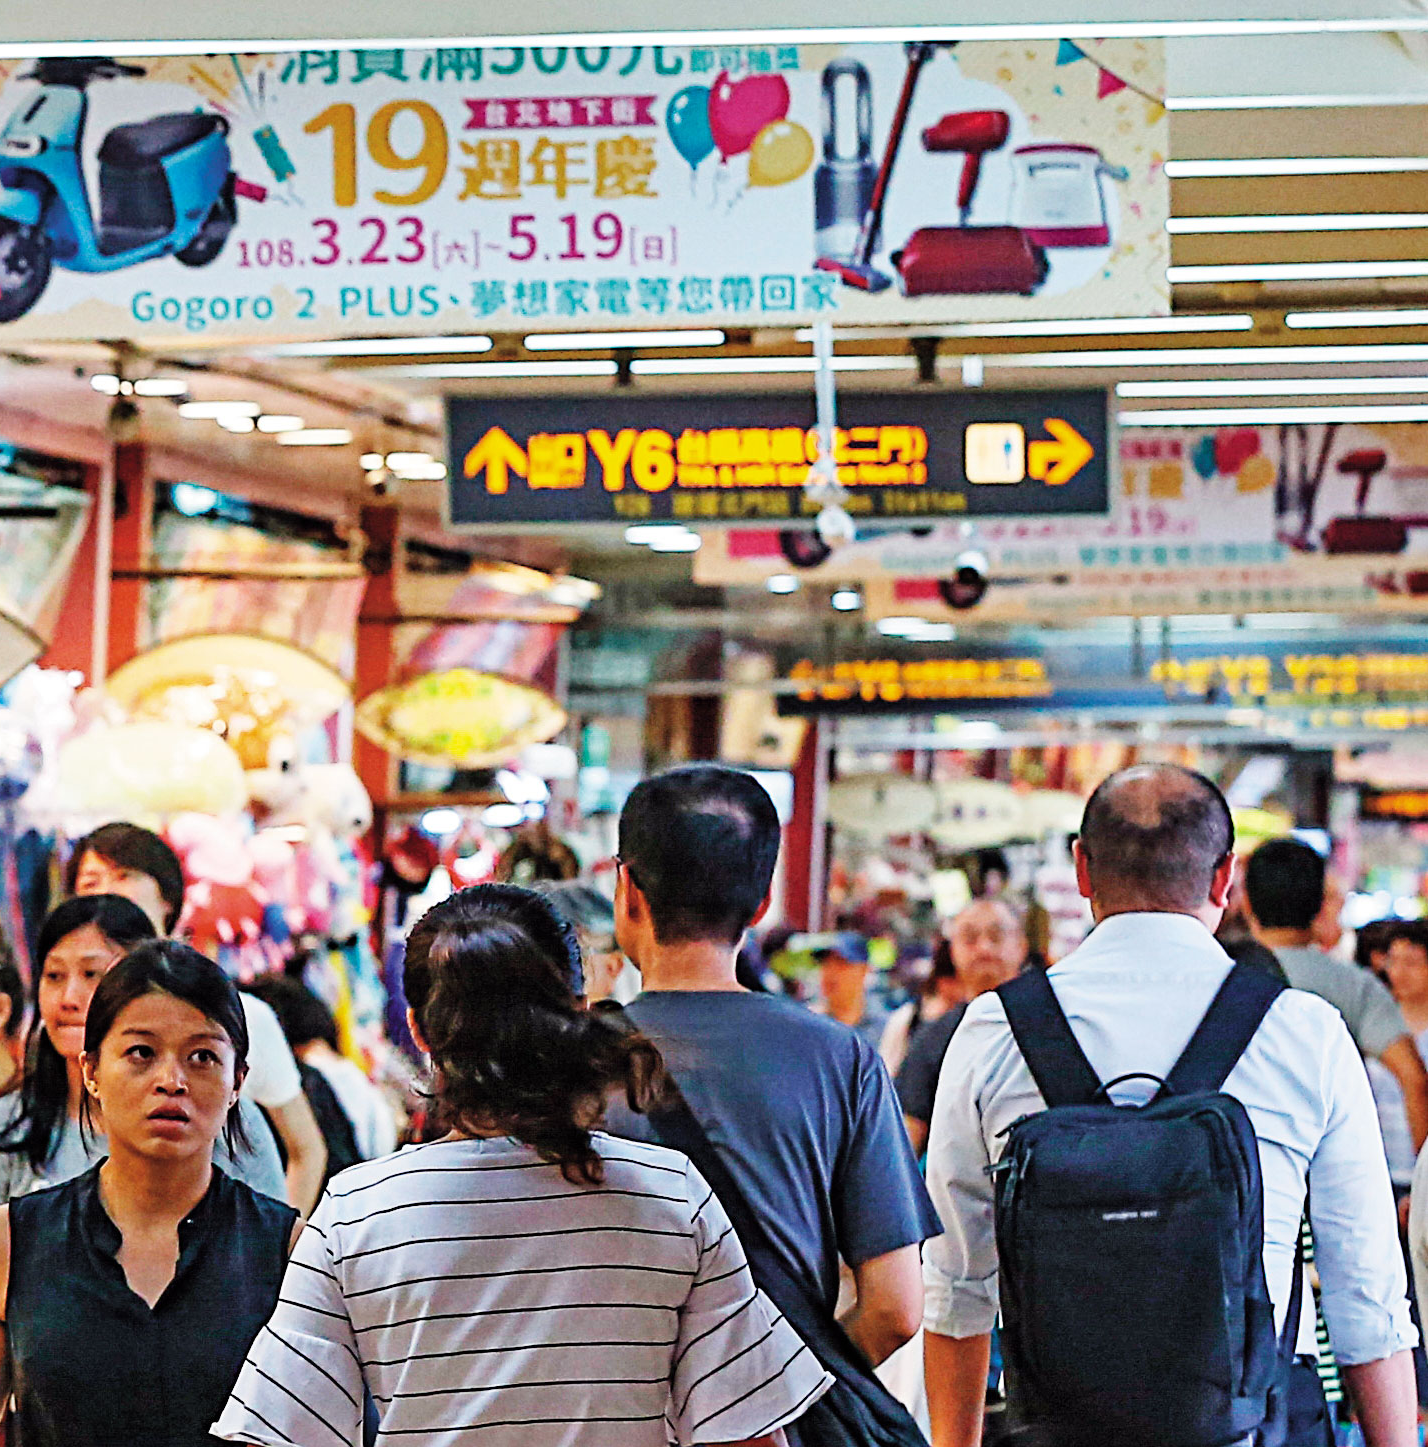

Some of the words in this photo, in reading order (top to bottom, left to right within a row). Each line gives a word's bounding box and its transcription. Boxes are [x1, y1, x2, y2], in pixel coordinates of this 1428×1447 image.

[304, 100, 449, 207] 19
[458, 134, 658, 202] 週年慶
[131, 290, 274, 331] Gogoro
[295, 287, 316, 319] 2
[586, 428, 676, 491] Y6
